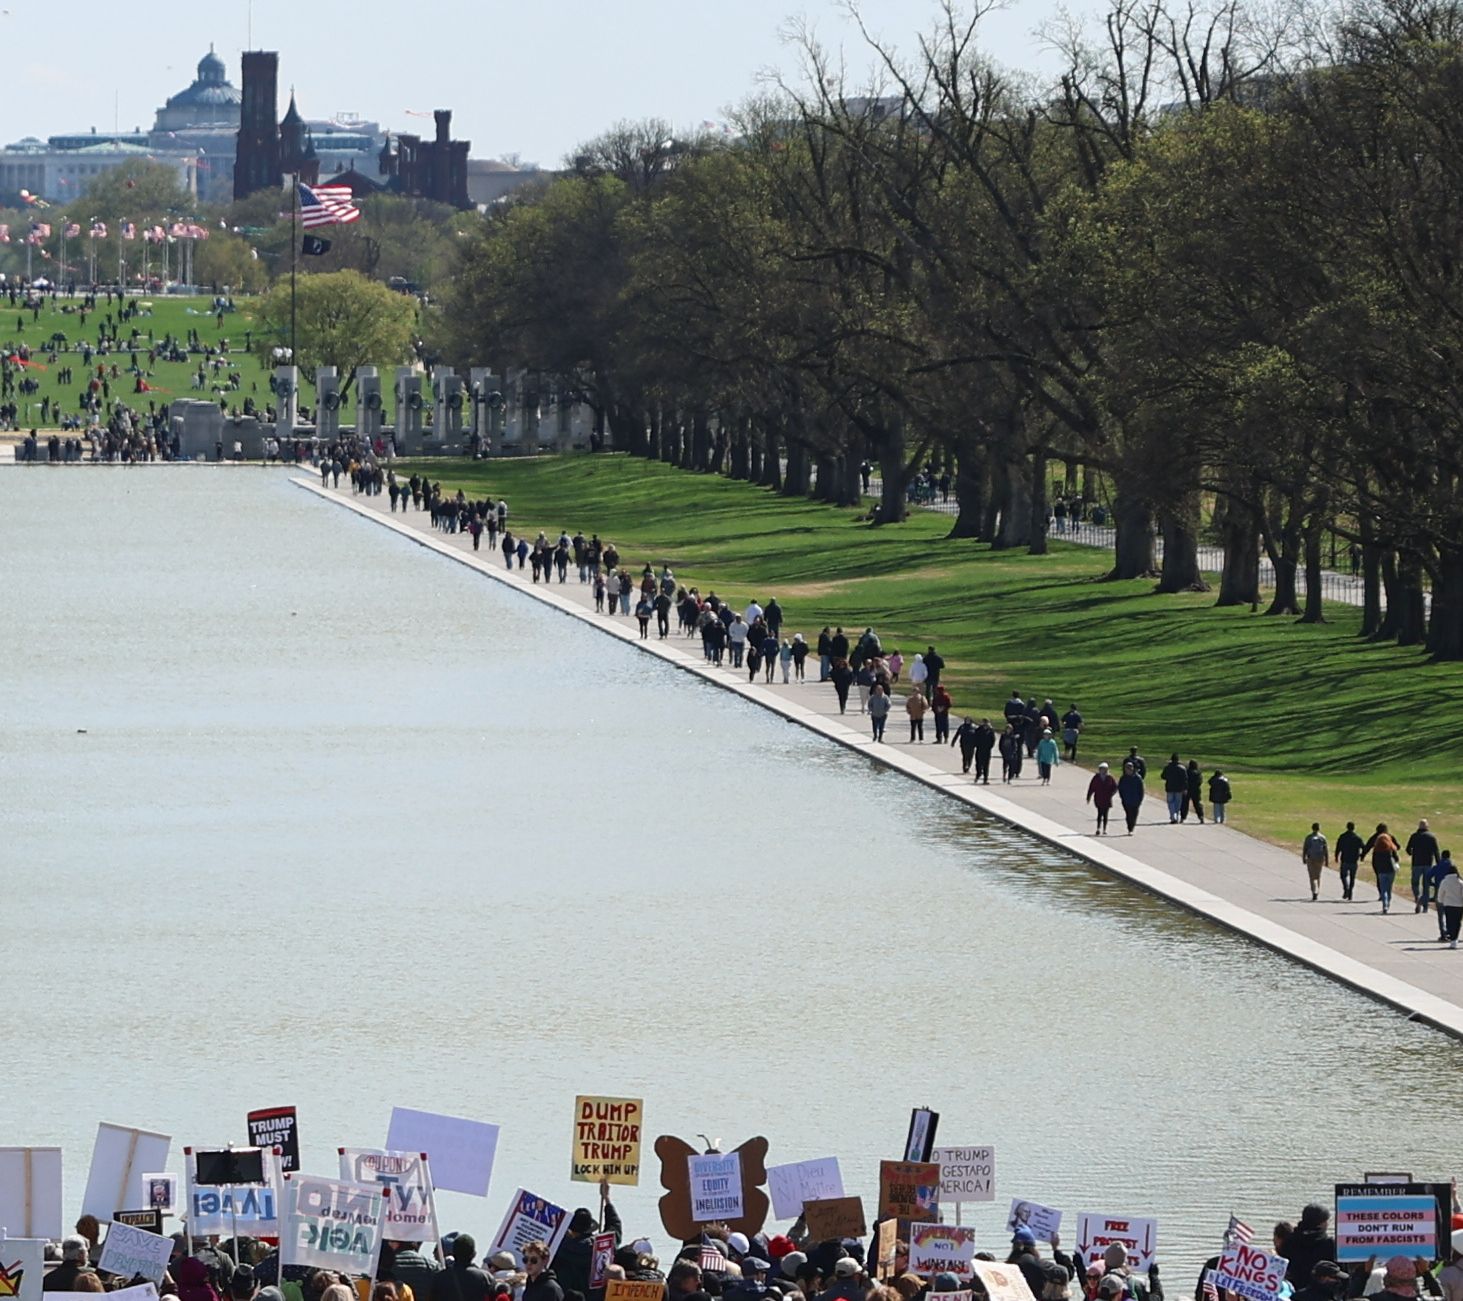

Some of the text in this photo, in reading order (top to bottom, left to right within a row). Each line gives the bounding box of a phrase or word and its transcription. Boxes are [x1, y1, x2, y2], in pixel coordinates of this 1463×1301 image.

[581, 1101, 638, 1121] DUMP
[249, 1116, 294, 1134] TRUMP
[256, 1130, 290, 1145] MUST
[577, 1122, 640, 1143] TRAITOR
[581, 1142, 633, 1161] TRUMP
[945, 1149, 990, 1162] TRUMP
[574, 1164, 601, 1175] LOCK
[624, 1164, 640, 1176] UP!
[693, 1158, 735, 1174] DIVERSITY
[942, 1165, 992, 1178] GESTAPO
[702, 1178, 729, 1192] EQUITY
[1342, 1188, 1407, 1197] REMEMBER
[695, 1196, 740, 1211] INCLUSION
[1345, 1211, 1425, 1221] THESE COLORS
[1104, 1220, 1130, 1232] FREE
[1357, 1223, 1414, 1233] DON'T RUN
[112, 1224, 164, 1253] SAVE
[1345, 1234, 1426, 1244] FROM FASCISTS
[933, 1242, 955, 1251] NOT
[1236, 1246, 1269, 1272] NO
[1217, 1255, 1279, 1292] KINGS
[612, 1283, 660, 1297] IMPEACH
